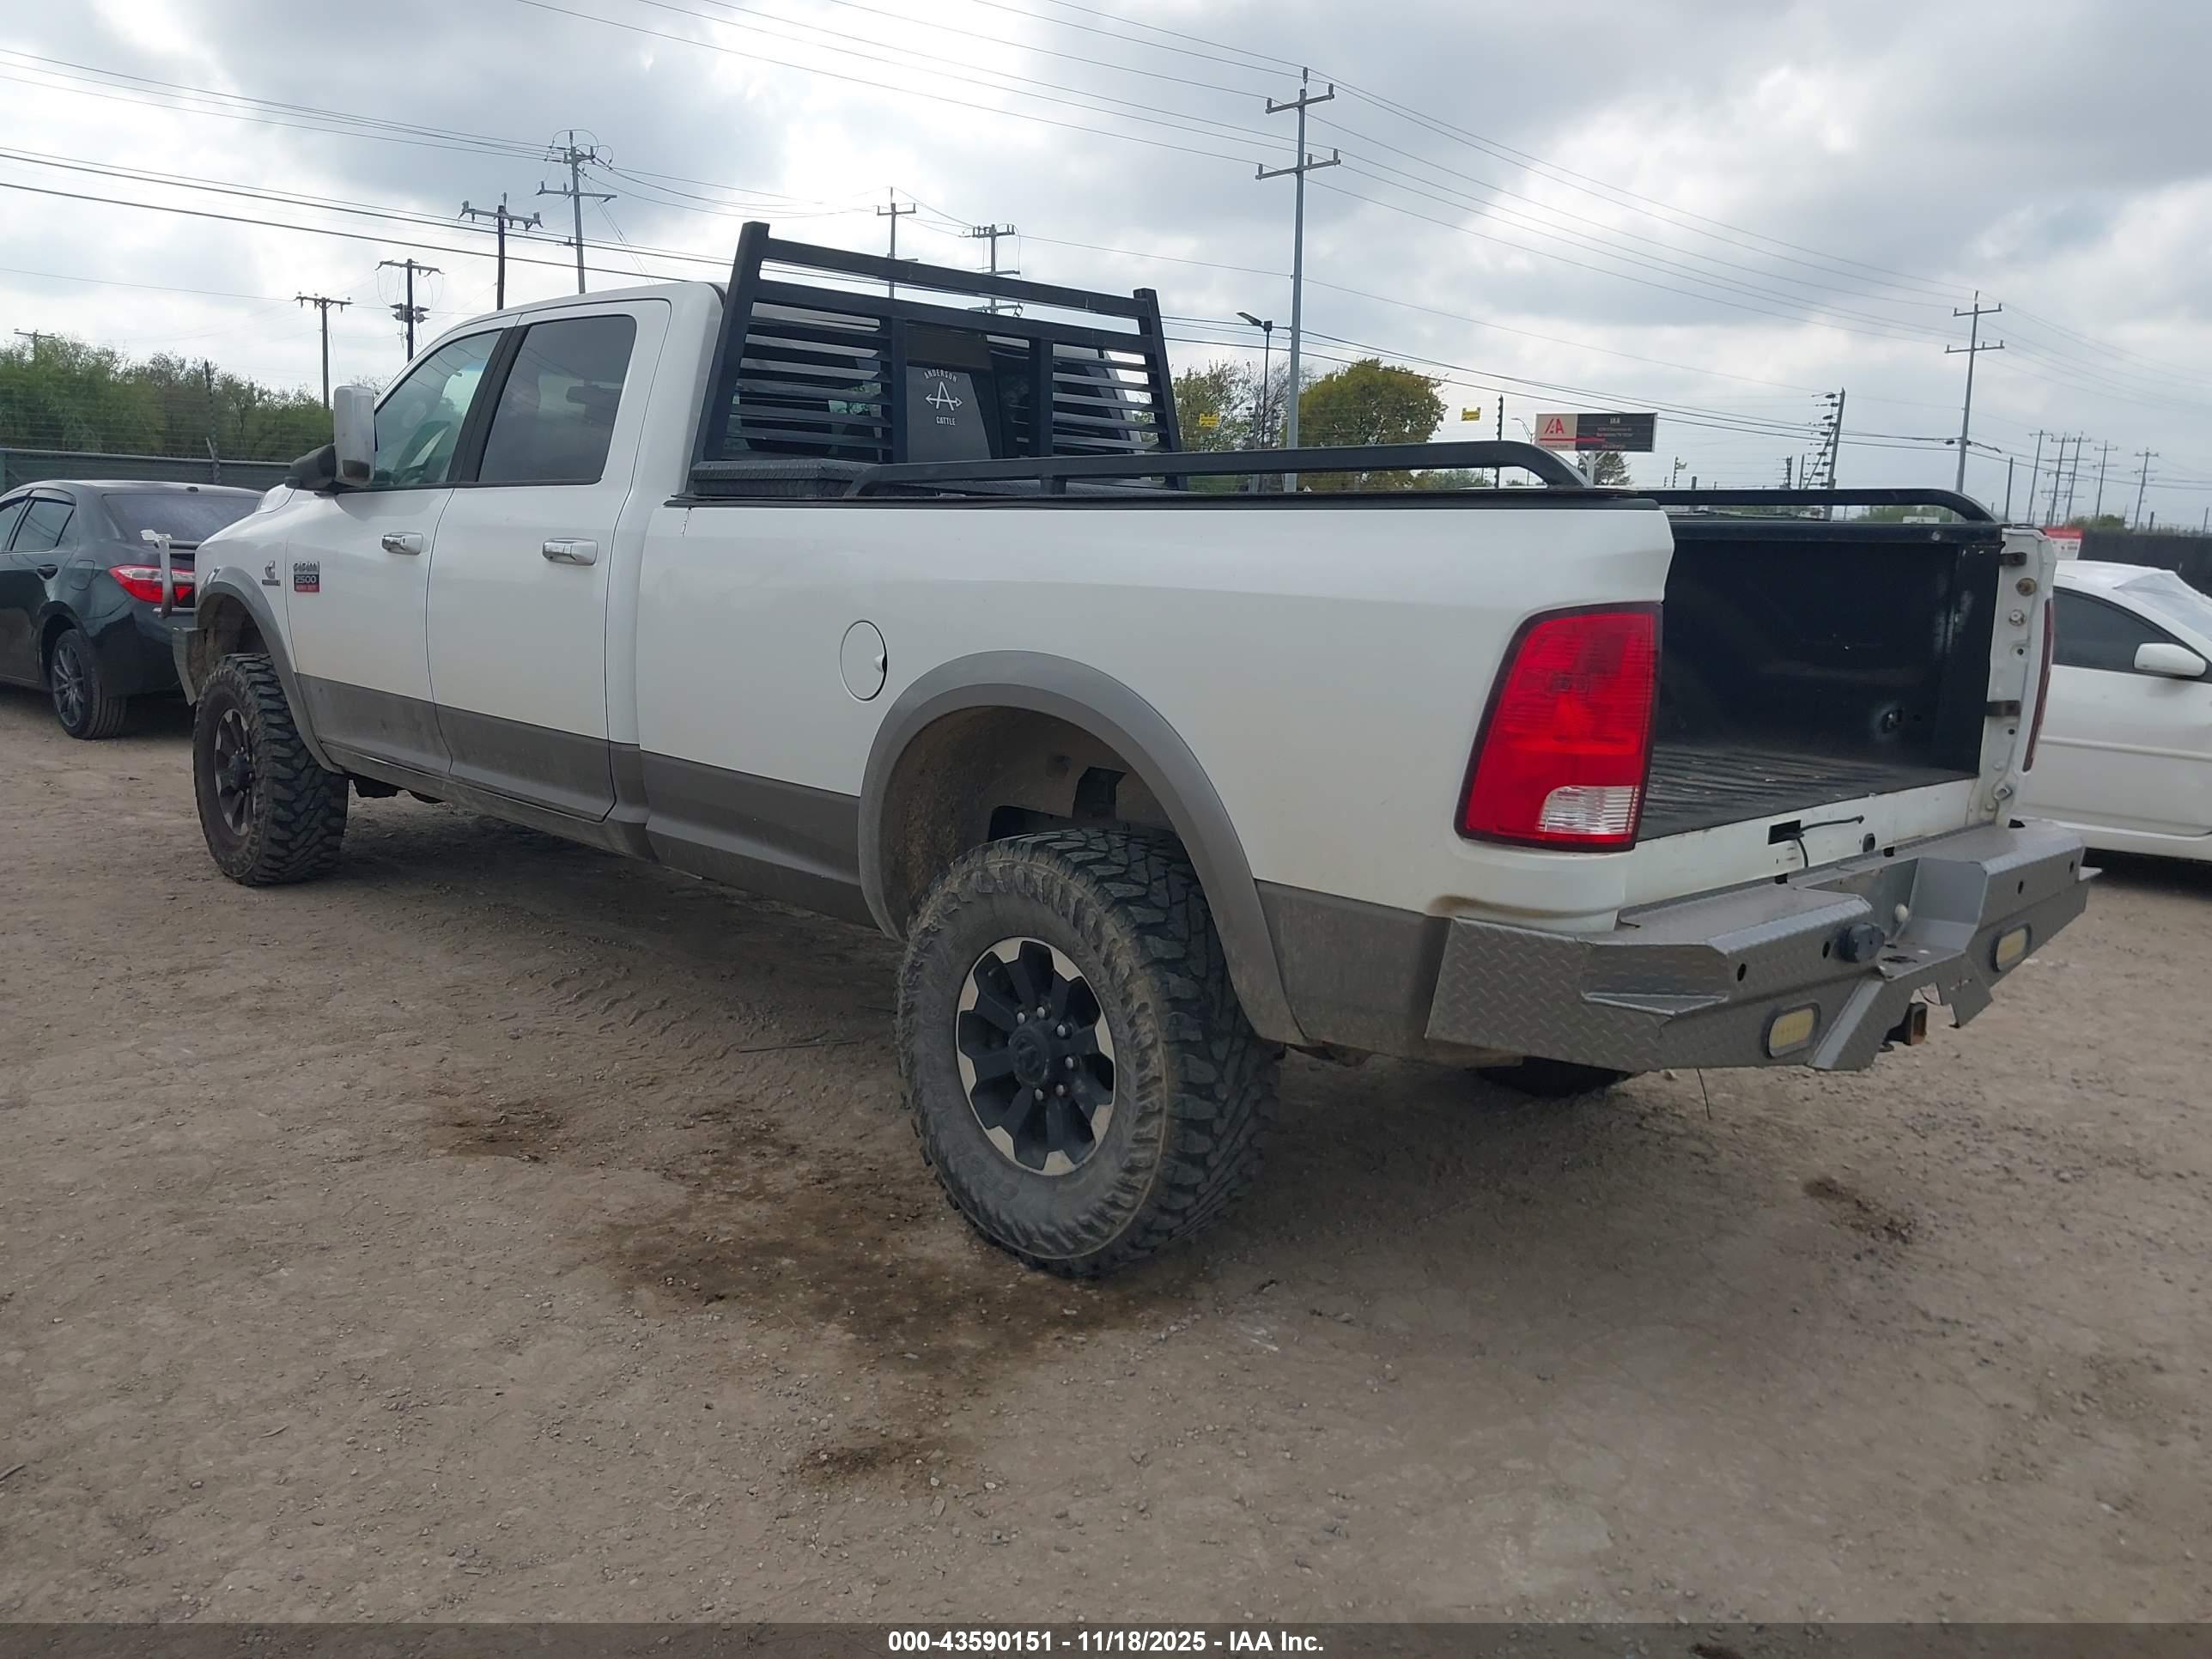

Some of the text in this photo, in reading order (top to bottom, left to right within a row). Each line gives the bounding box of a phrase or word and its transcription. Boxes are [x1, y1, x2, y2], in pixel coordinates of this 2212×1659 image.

[923, 368, 957, 383] ANDERSON
[936, 416, 956, 426] CATTLE
[295, 575, 317, 584] 2500
